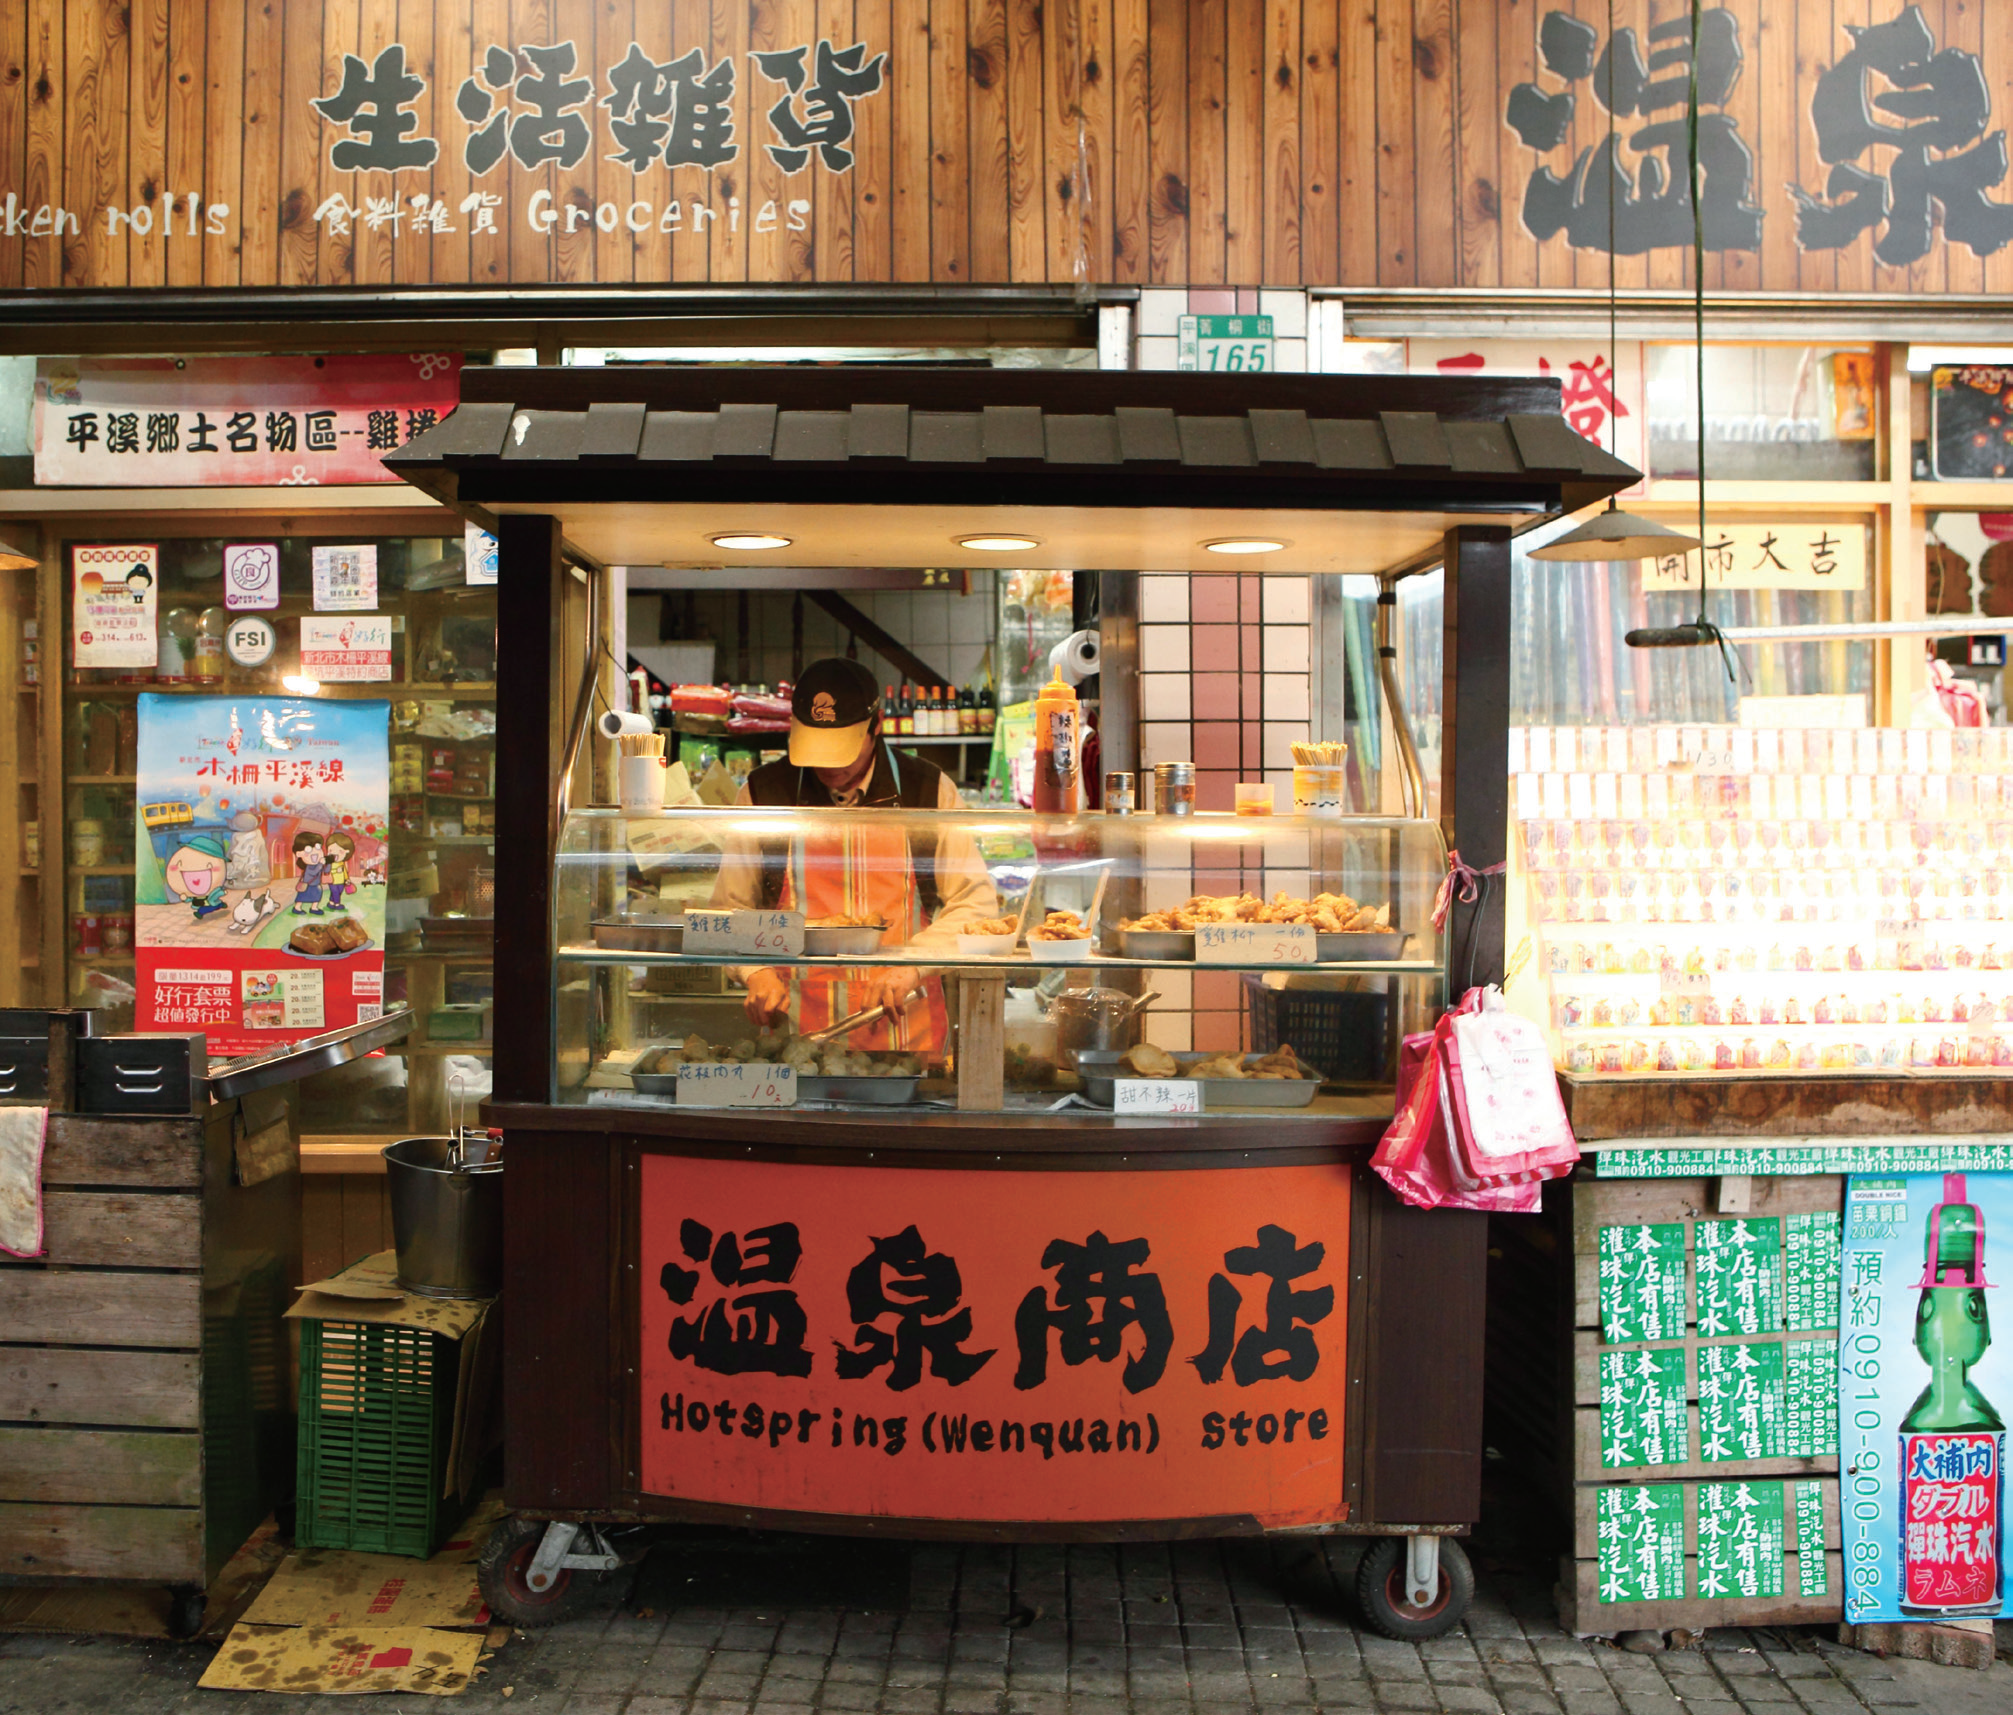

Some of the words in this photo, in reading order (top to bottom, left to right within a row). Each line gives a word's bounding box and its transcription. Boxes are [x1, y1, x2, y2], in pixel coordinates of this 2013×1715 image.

[310, 40, 887, 175] 生活雜貨
[107, 191, 229, 237] rolls
[527, 189, 812, 236] Groceries
[1208, 344, 1266, 371] 165
[234, 631, 266, 647] FSI
[154, 985, 232, 1006] 好行套票
[1631, 1225, 1663, 1340] 本店有售
[1727, 1219, 1759, 1334] 本店有售
[1632, 1351, 1665, 1465] 本店有售
[1730, 1344, 1763, 1458] 本店有售
[1910, 1439, 1993, 1483] 大補內
[1629, 1487, 1661, 1600] 本店有售
[1730, 1483, 1760, 1597] 本店有售
[1913, 1566, 1989, 1600] ラムネ
